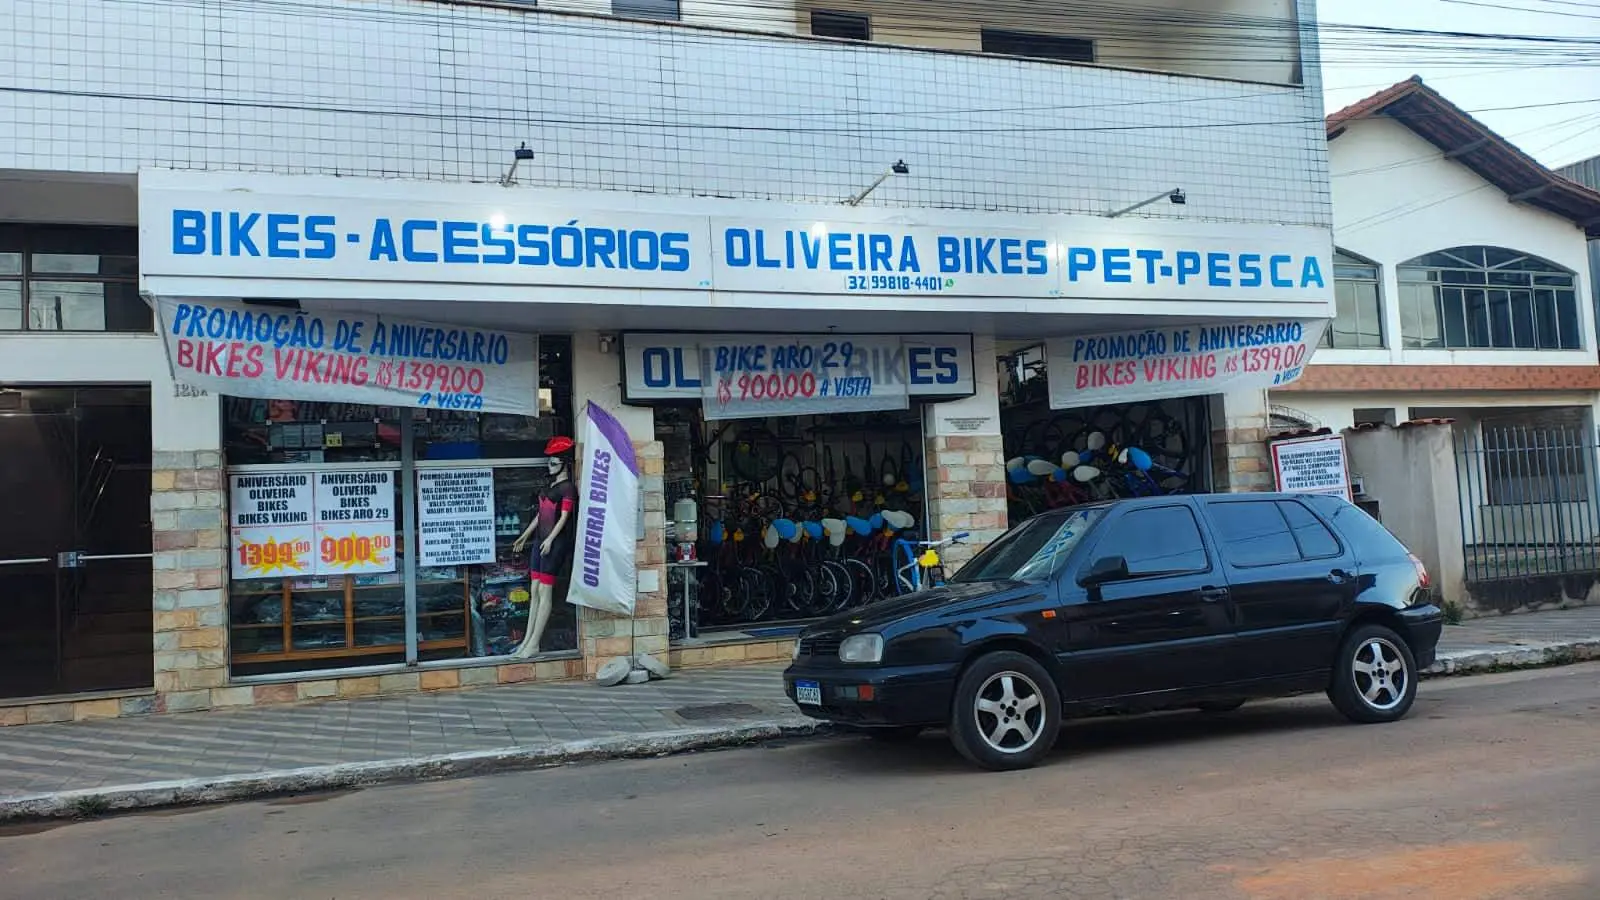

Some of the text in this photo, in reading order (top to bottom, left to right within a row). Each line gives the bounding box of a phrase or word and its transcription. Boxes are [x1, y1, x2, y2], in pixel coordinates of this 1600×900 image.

[172, 210, 336, 259] BIKES
[369, 218, 690, 272] ACESSÓRIOS
[724, 228, 1048, 274] OLIVEIRA BIKES
[1068, 247, 1325, 289] PET-PESCA
[172, 303, 509, 365] PROMOÇÃO DE ANIVERSARIO
[1072, 321, 1302, 363] PROMOÇÃO DE ANIVERSARIO
[177, 338, 264, 378] BIKES
[273, 348, 369, 386] VIKING
[375, 360, 392, 389] R$
[714, 341, 854, 372] BIKE ARO 29
[1075, 360, 1137, 390] BIKES
[1143, 354, 1217, 383] VIKING
[1223, 352, 1238, 373] R$
[835, 376, 872, 397] VISTA
[436, 392, 484, 410] VISTA
[237, 474, 307, 488] ANIVERSÁRIO
[320, 472, 388, 485] ANIVERSÁRIO
[249, 488, 296, 500] OLIVEIRA
[332, 485, 377, 497] OLIVEIRA
[257, 500, 288, 512] BIKES
[340, 497, 370, 508] BIKES
[238, 511, 308, 525] BIKES VIKING
[321, 508, 389, 521] BIKES ARO 29
[583, 448, 612, 588] OLIVEIRA BIKES
